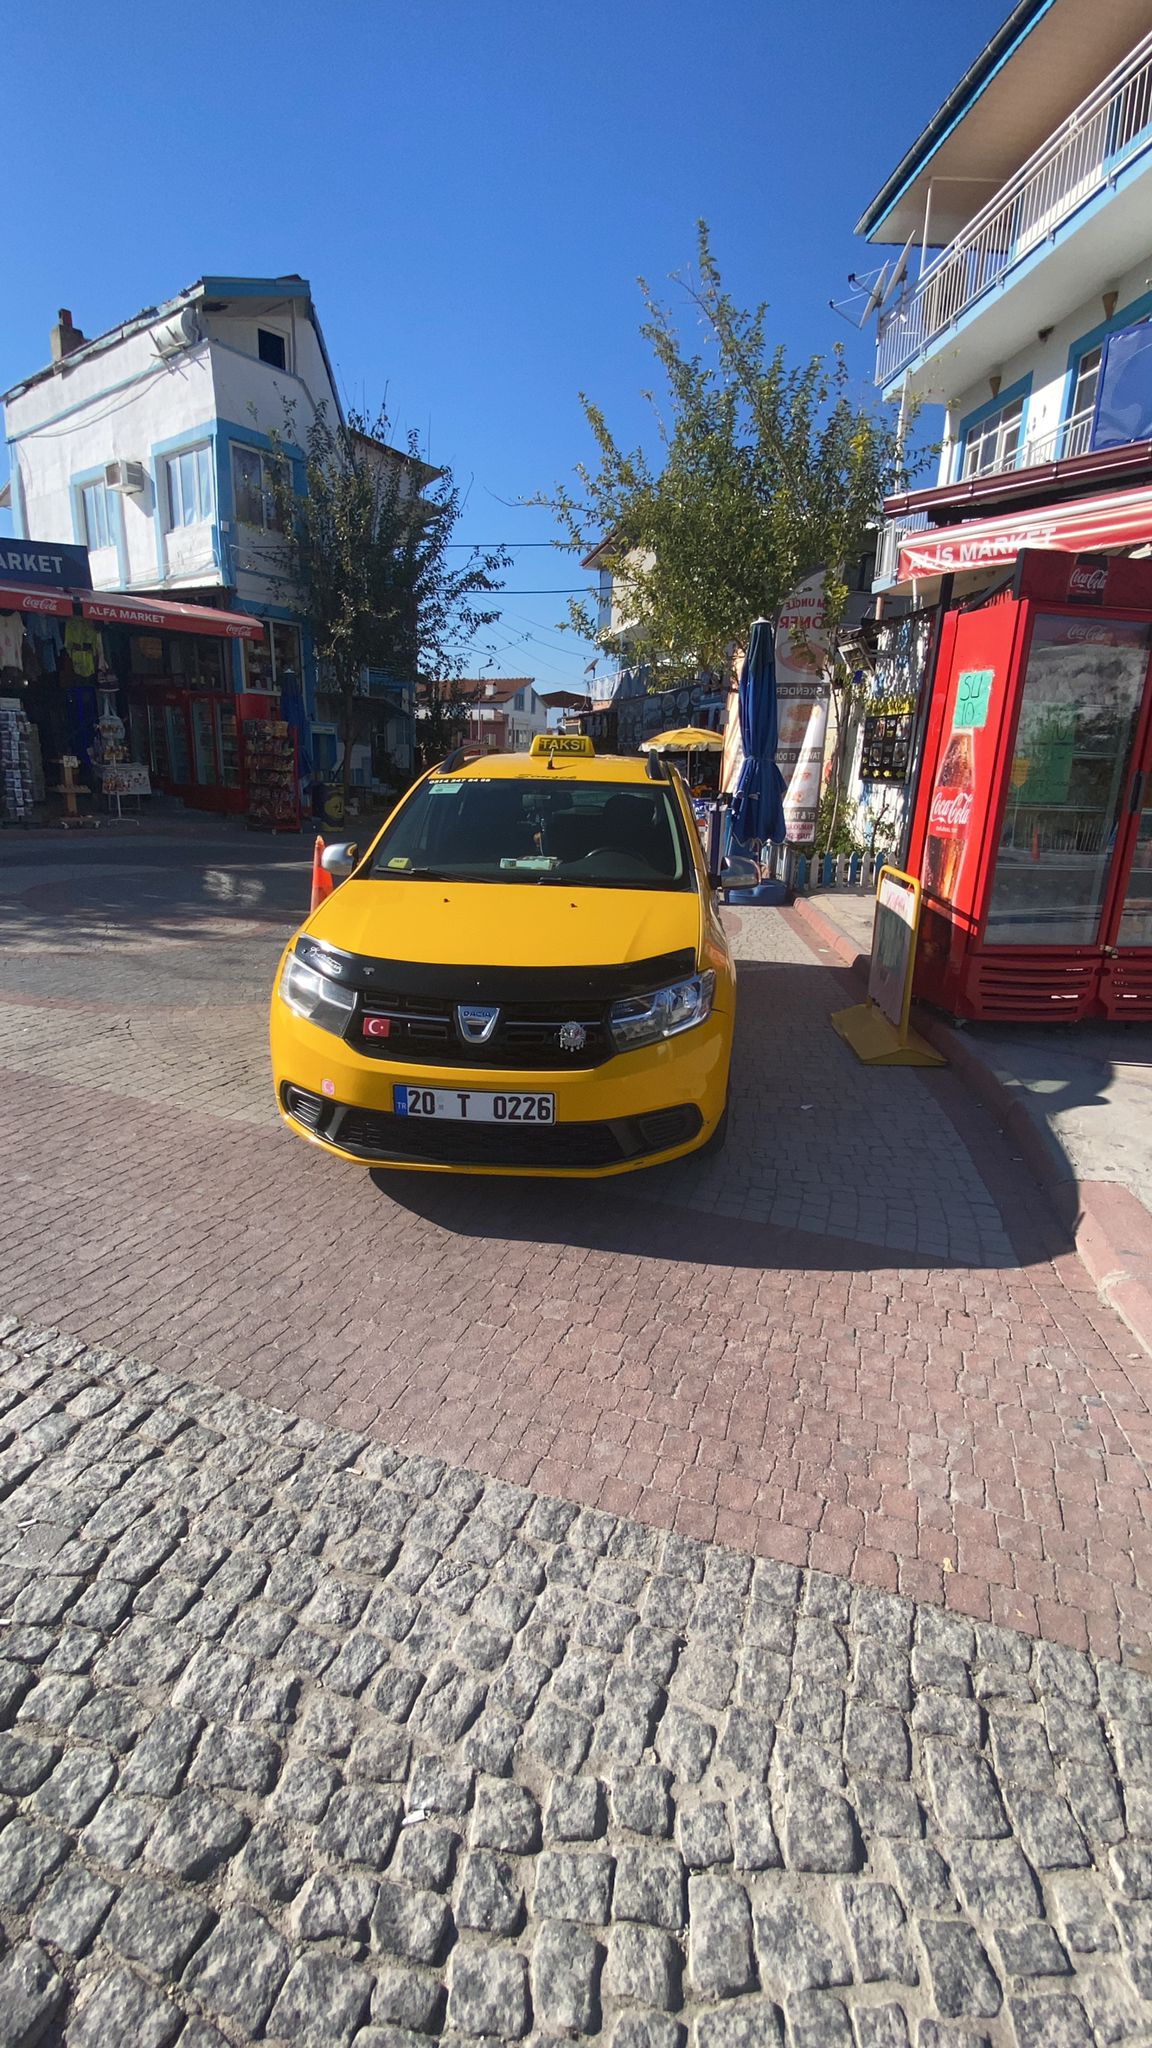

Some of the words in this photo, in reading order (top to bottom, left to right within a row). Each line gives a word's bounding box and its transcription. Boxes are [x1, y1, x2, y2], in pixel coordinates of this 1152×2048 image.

[959, 527, 1057, 563] MARKET
[88, 606, 117, 617] ALFA
[120, 609, 166, 624] MARKET
[397, 1101, 407, 1111] TR
[408, 1090, 436, 1115] 20
[457, 1093, 471, 1118] T
[493, 1096, 551, 1120] 0226
